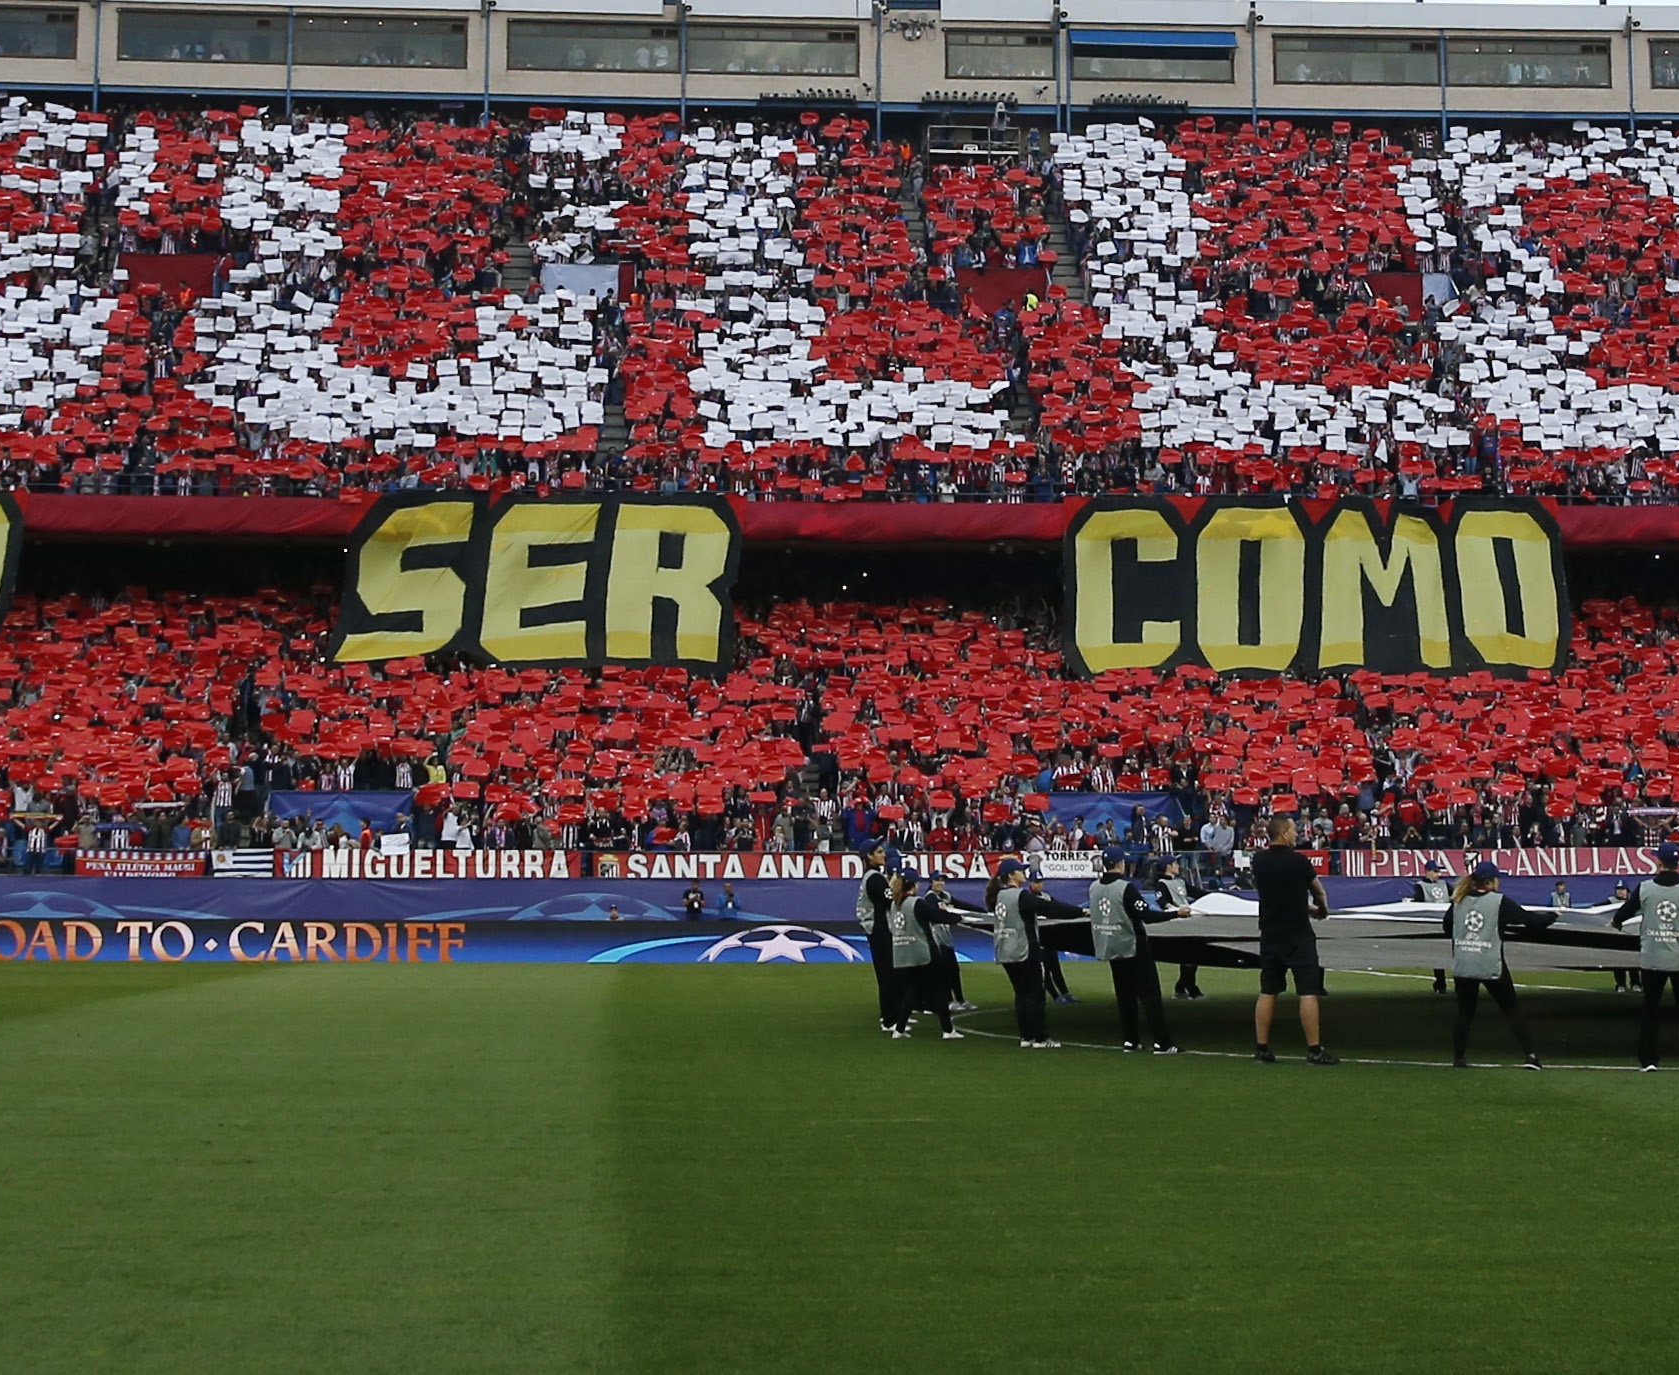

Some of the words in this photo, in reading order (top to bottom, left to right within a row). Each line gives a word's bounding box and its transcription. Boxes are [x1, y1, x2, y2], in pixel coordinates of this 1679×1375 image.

[334, 501, 731, 663] SER
[1074, 506, 1560, 675] COMO
[321, 848, 570, 879] MIGUELTURRA
[626, 853, 722, 879] SANTA
[756, 854, 830, 879] ANA
[1045, 850, 1090, 861] TORRES
[1492, 845, 1659, 877] CANILLAS
[116, 921, 194, 962] TO
[229, 921, 466, 963] CARDIFF
